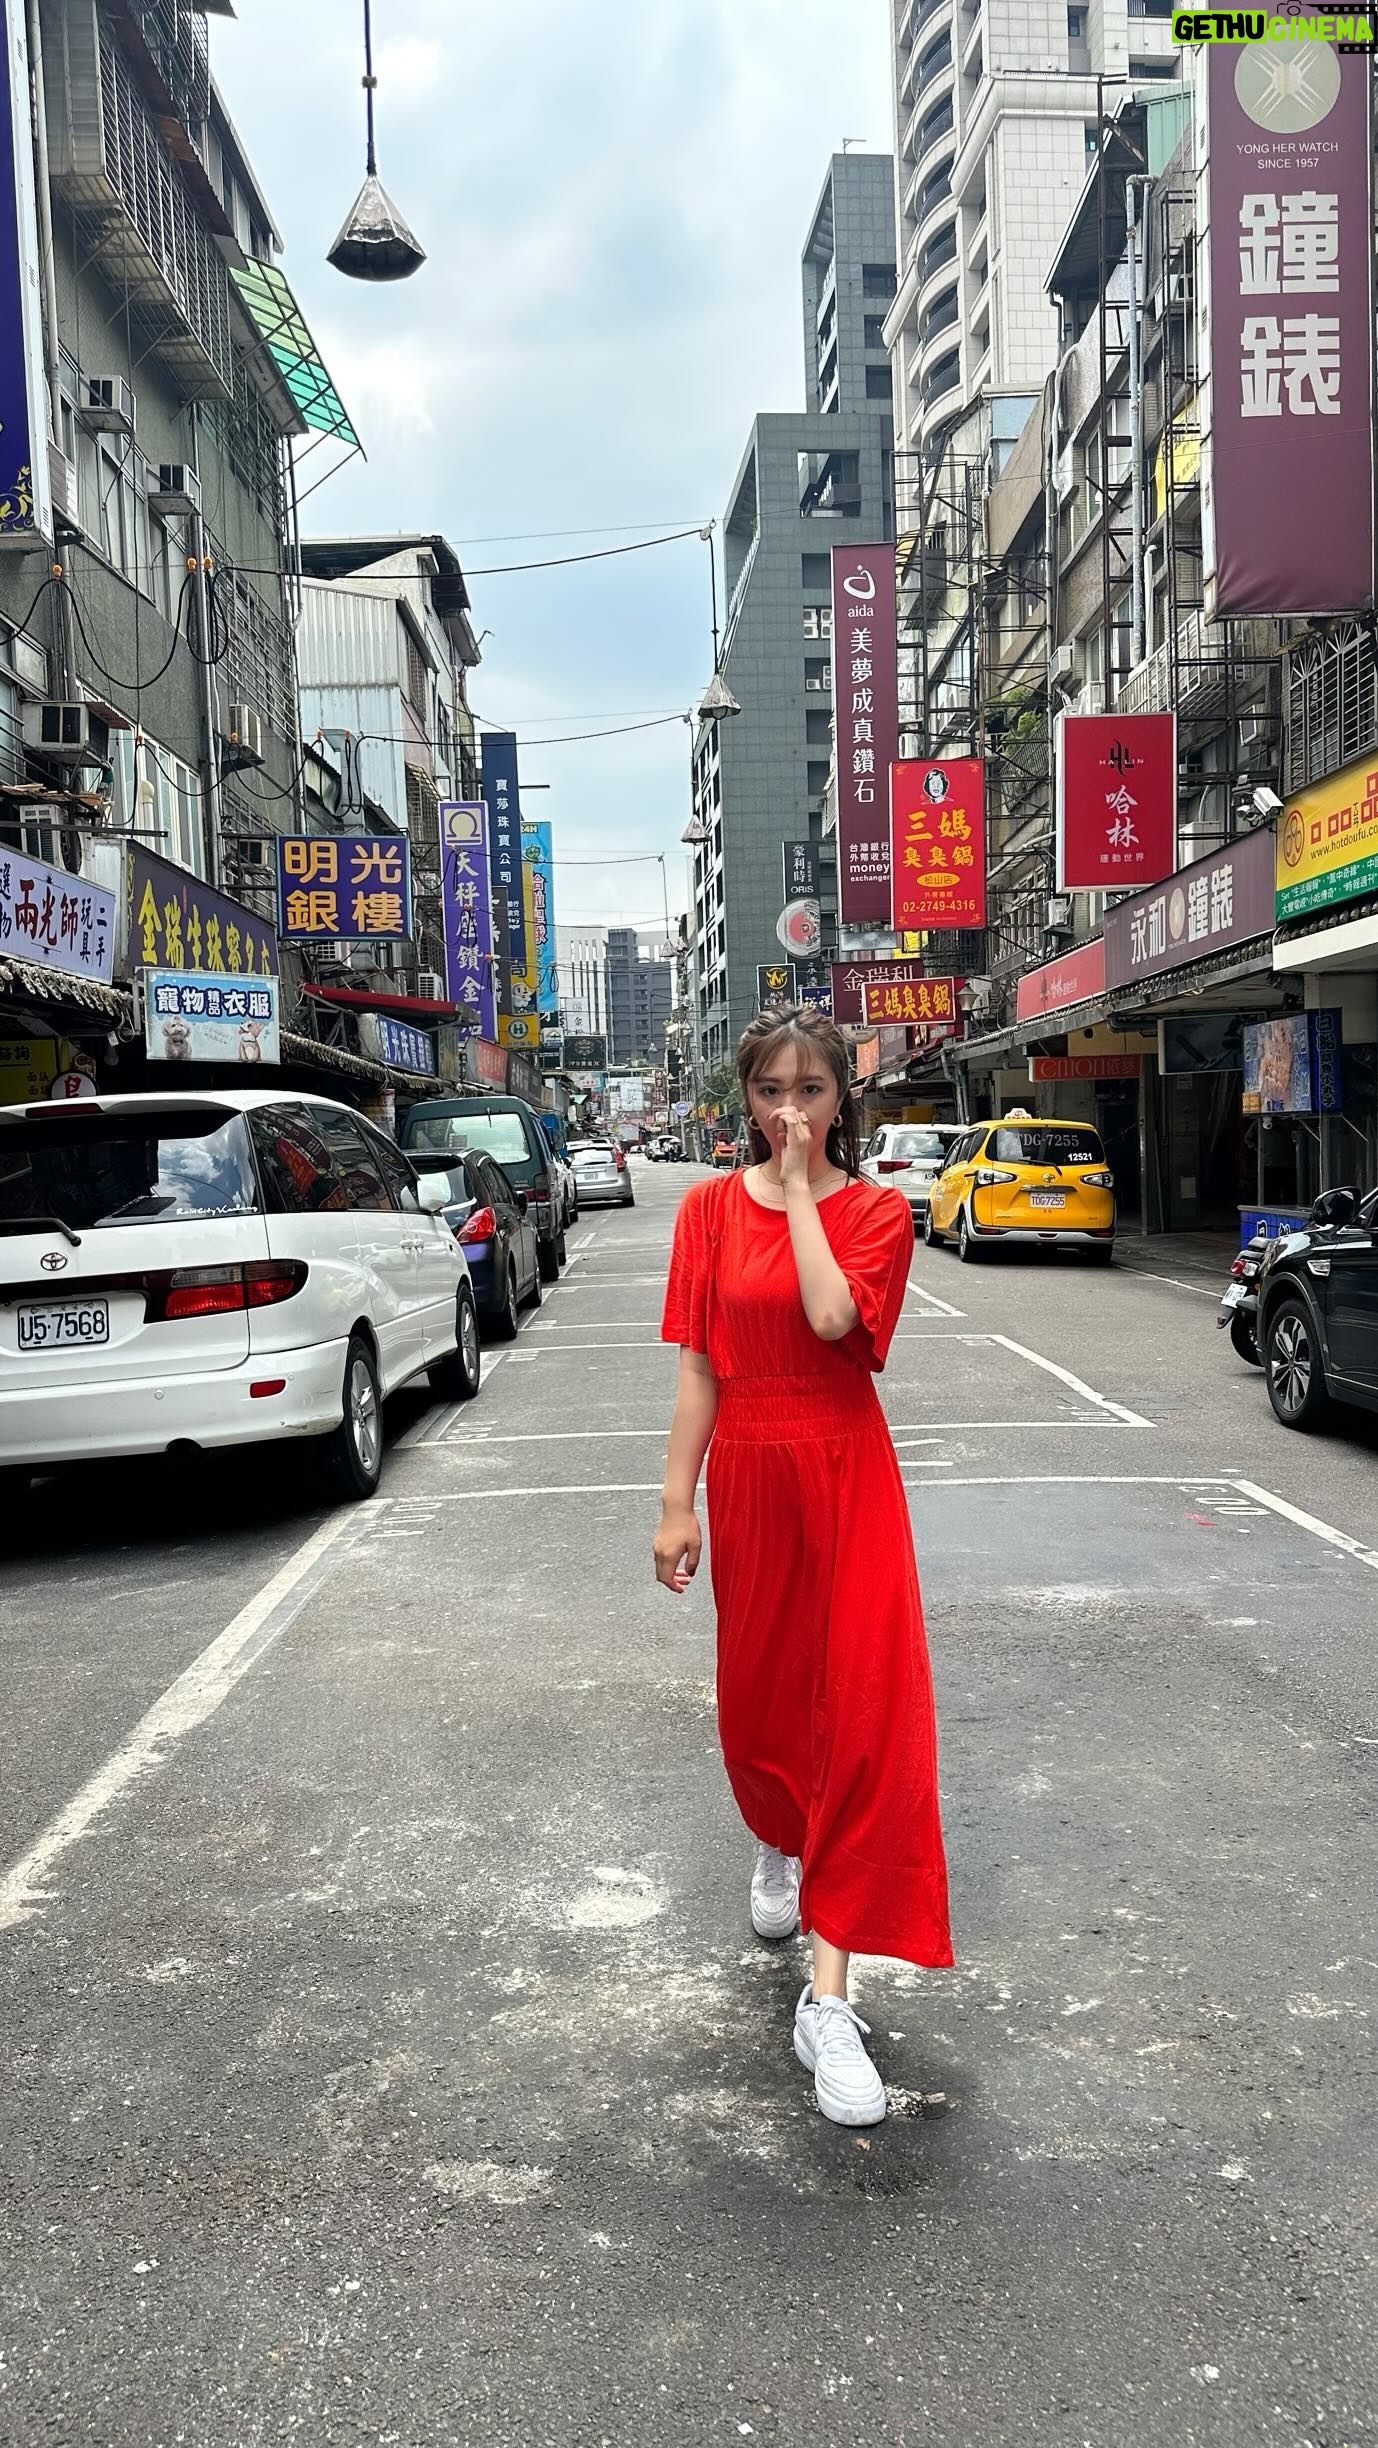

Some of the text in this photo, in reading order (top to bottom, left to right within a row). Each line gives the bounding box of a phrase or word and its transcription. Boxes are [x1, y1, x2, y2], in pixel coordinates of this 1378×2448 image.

[1237, 142, 1339, 154] YONG HER WATCH
[1257, 158, 1320, 169] SINCE 1957
[1239, 191, 1341, 418] 鐘錶
[848, 604, 874, 617] aida
[850, 627, 876, 803] 美夢成真鑽石
[904, 808, 972, 841] 三媽
[1104, 784, 1139, 848] 哈林
[283, 840, 403, 885] 明光
[850, 863, 890, 874] money
[902, 845, 975, 868] 臭臭鍋
[790, 885, 814, 894] ORIS
[903, 900, 976, 912] 02-2749-4316
[15, 879, 79, 952] 兩光師
[286, 890, 404, 933] 銀樓
[80, 897, 93, 964] 玩具
[96, 907, 107, 967] 二手
[1130, 895, 1166, 965] 永和
[868, 984, 951, 1020] 三媽臭臭鍋
[1067, 1153, 1093, 1161] 12521
